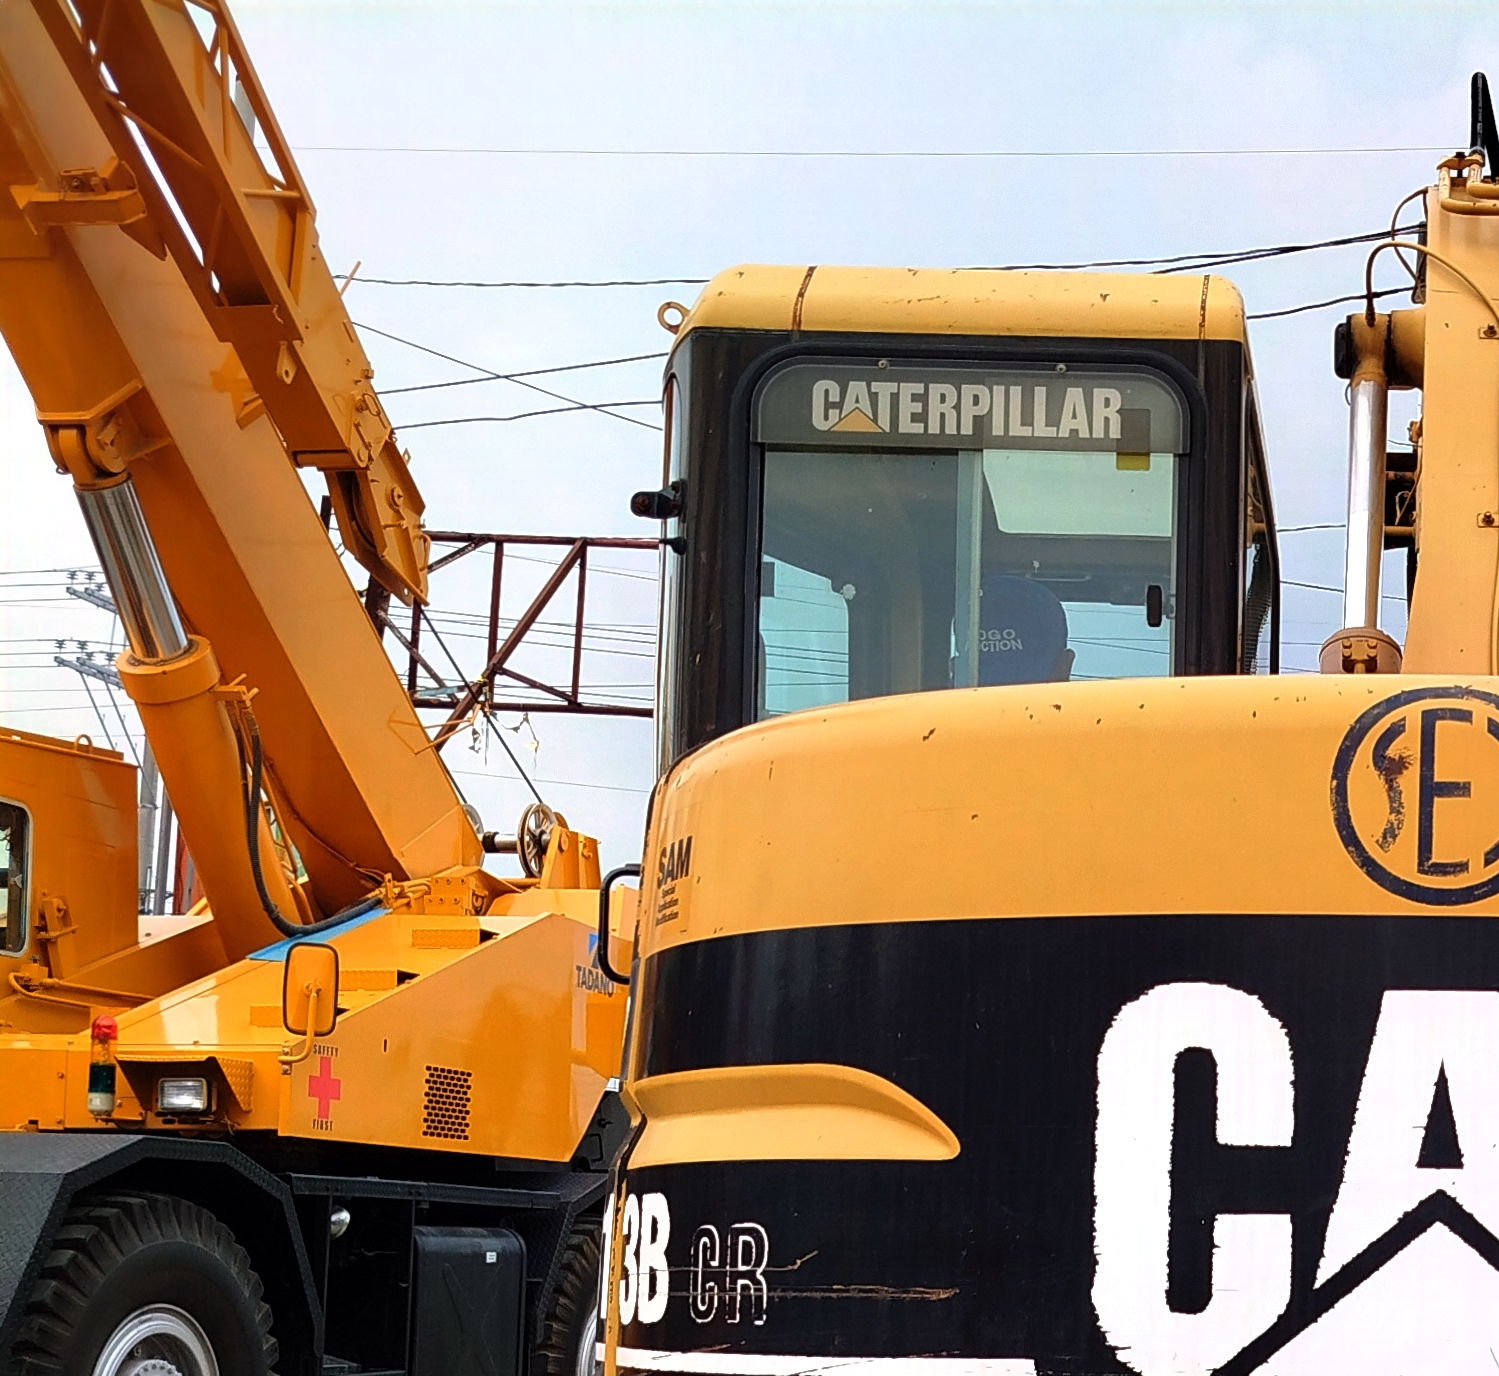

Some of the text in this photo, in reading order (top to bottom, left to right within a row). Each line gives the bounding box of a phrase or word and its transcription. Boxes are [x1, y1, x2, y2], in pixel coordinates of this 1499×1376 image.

[811, 379, 1122, 439] CATERPILLAR
[980, 638, 1024, 653] CTION
[656, 834, 693, 890] SAM
[575, 964, 615, 998] TADANO
[313, 1044, 339, 1057] SAFETY
[312, 1119, 333, 1131] FIRST
[689, 1222, 769, 1325] CR
